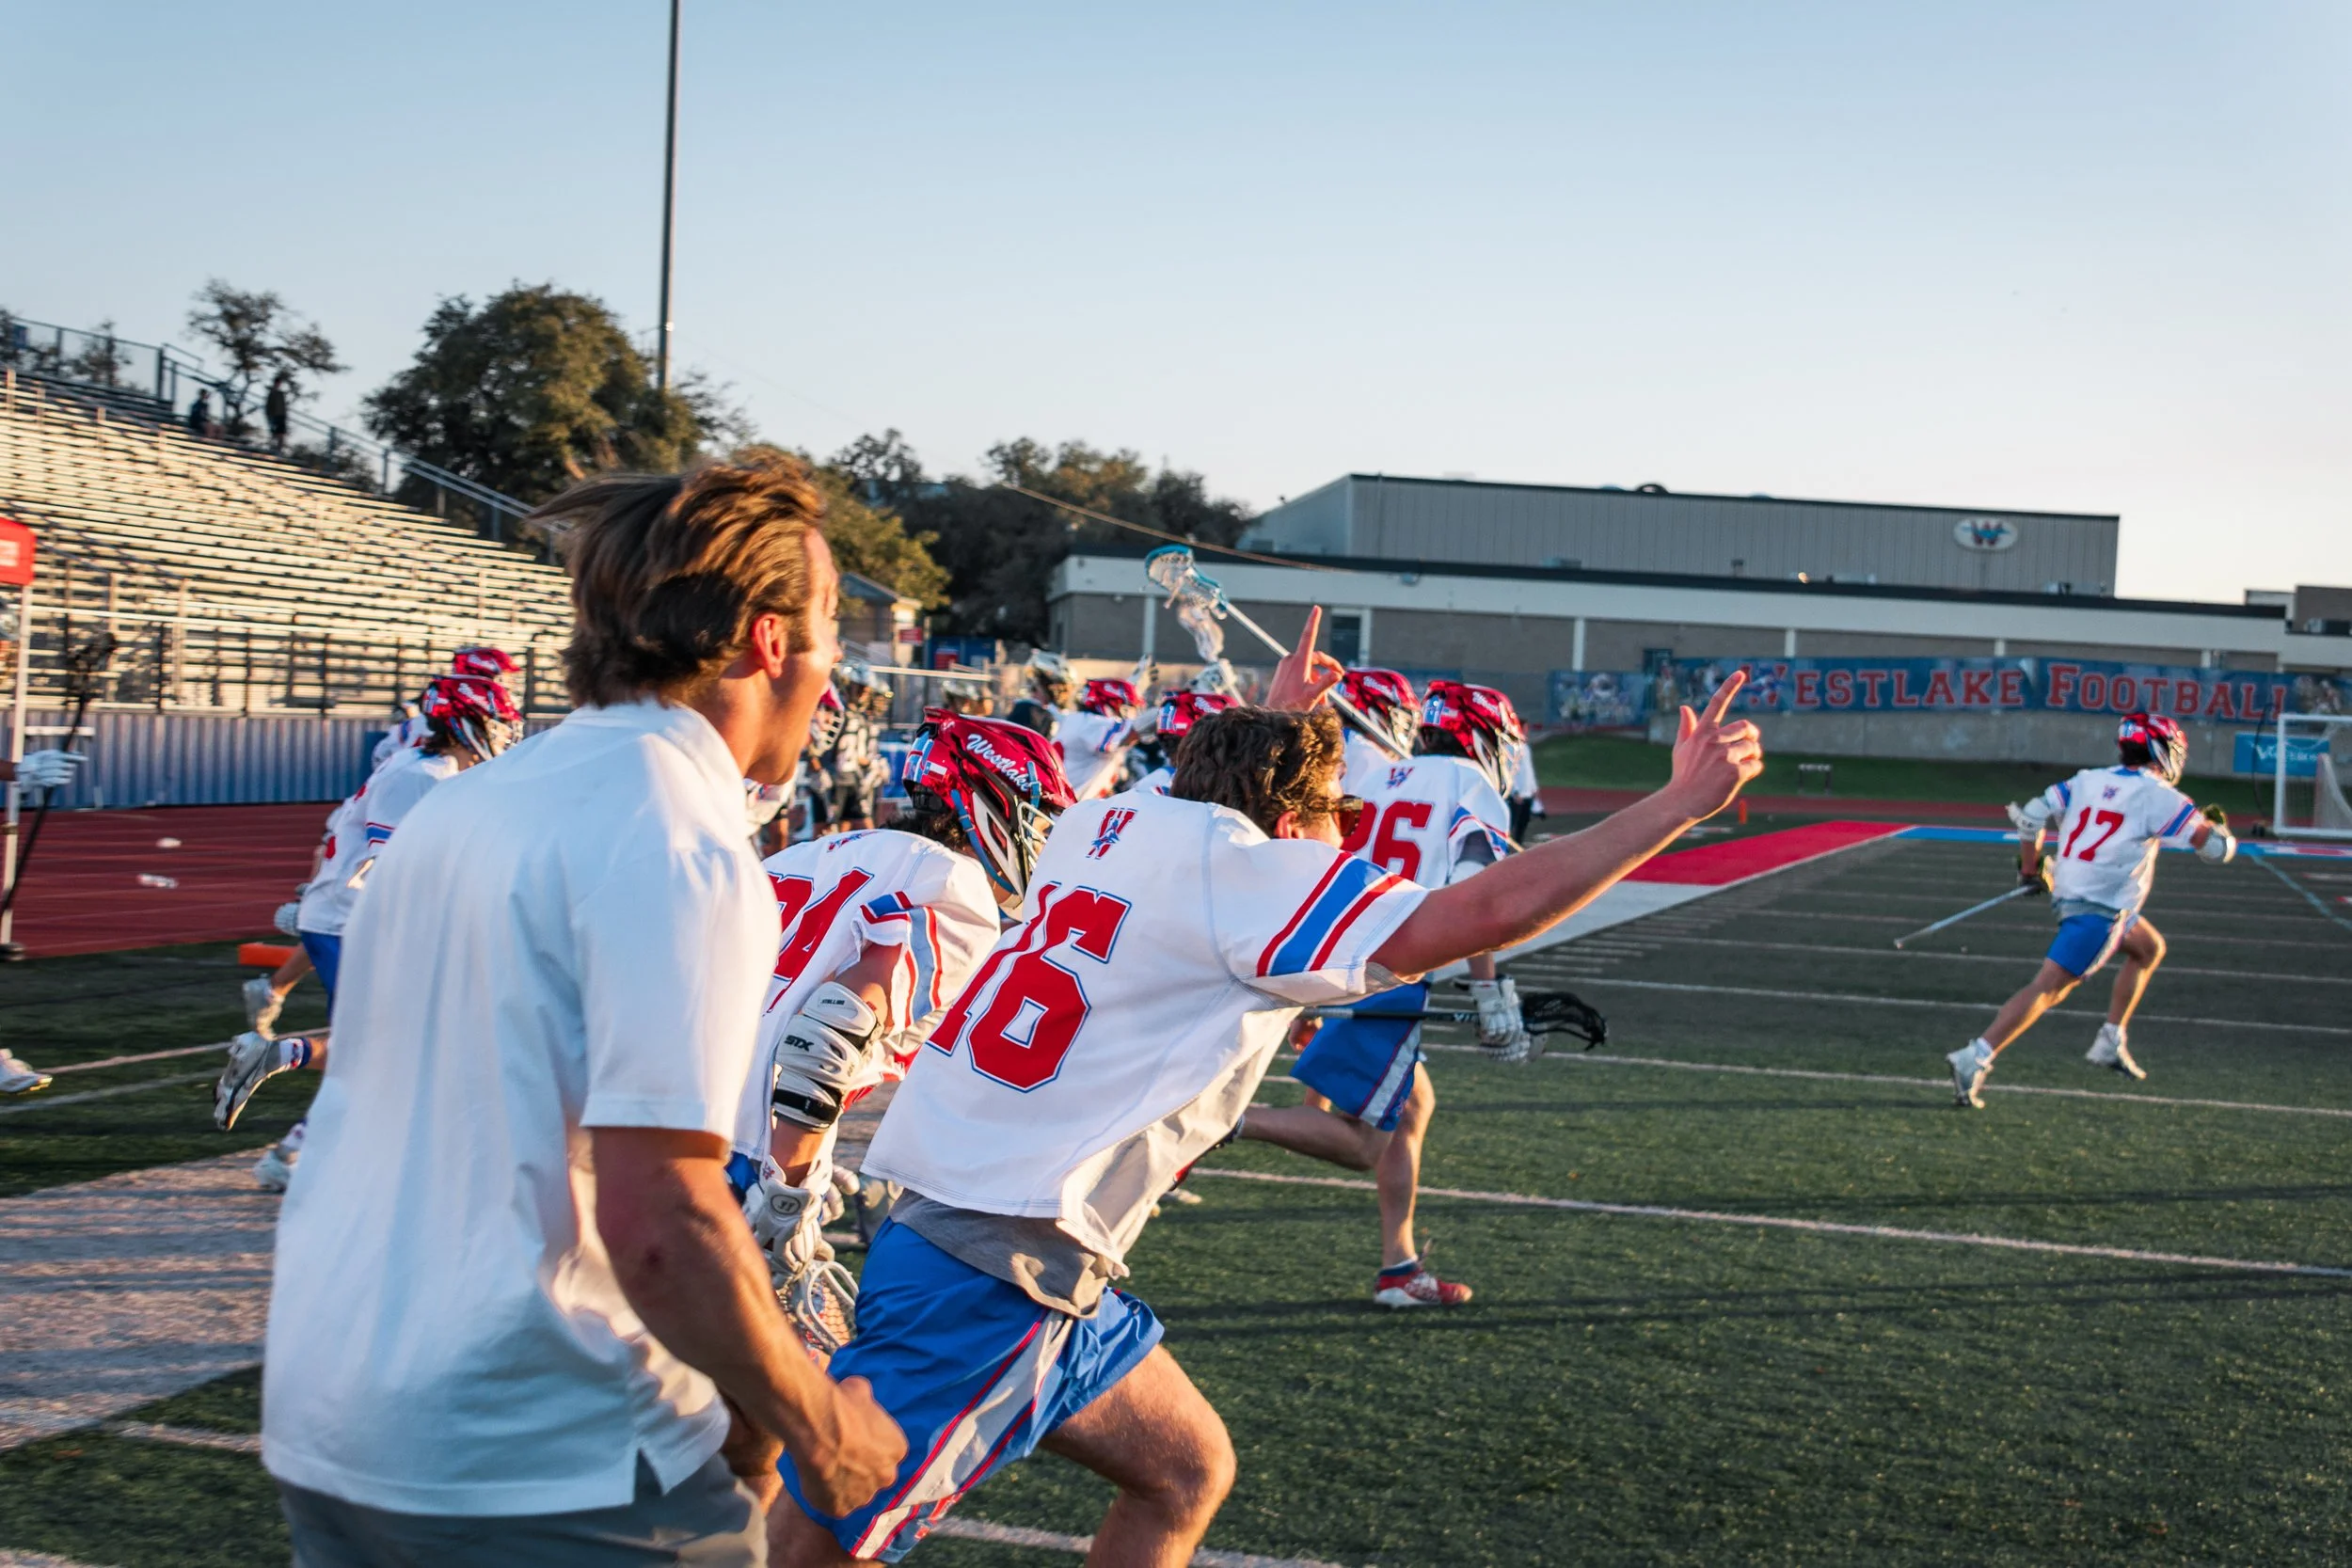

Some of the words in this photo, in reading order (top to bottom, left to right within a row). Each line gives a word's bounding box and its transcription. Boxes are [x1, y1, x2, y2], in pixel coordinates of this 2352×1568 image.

[966, 733, 1031, 792] Westlake
[2063, 806, 2124, 863] 17
[926, 880, 1131, 1093] 16
[784, 1035, 814, 1052] STX
